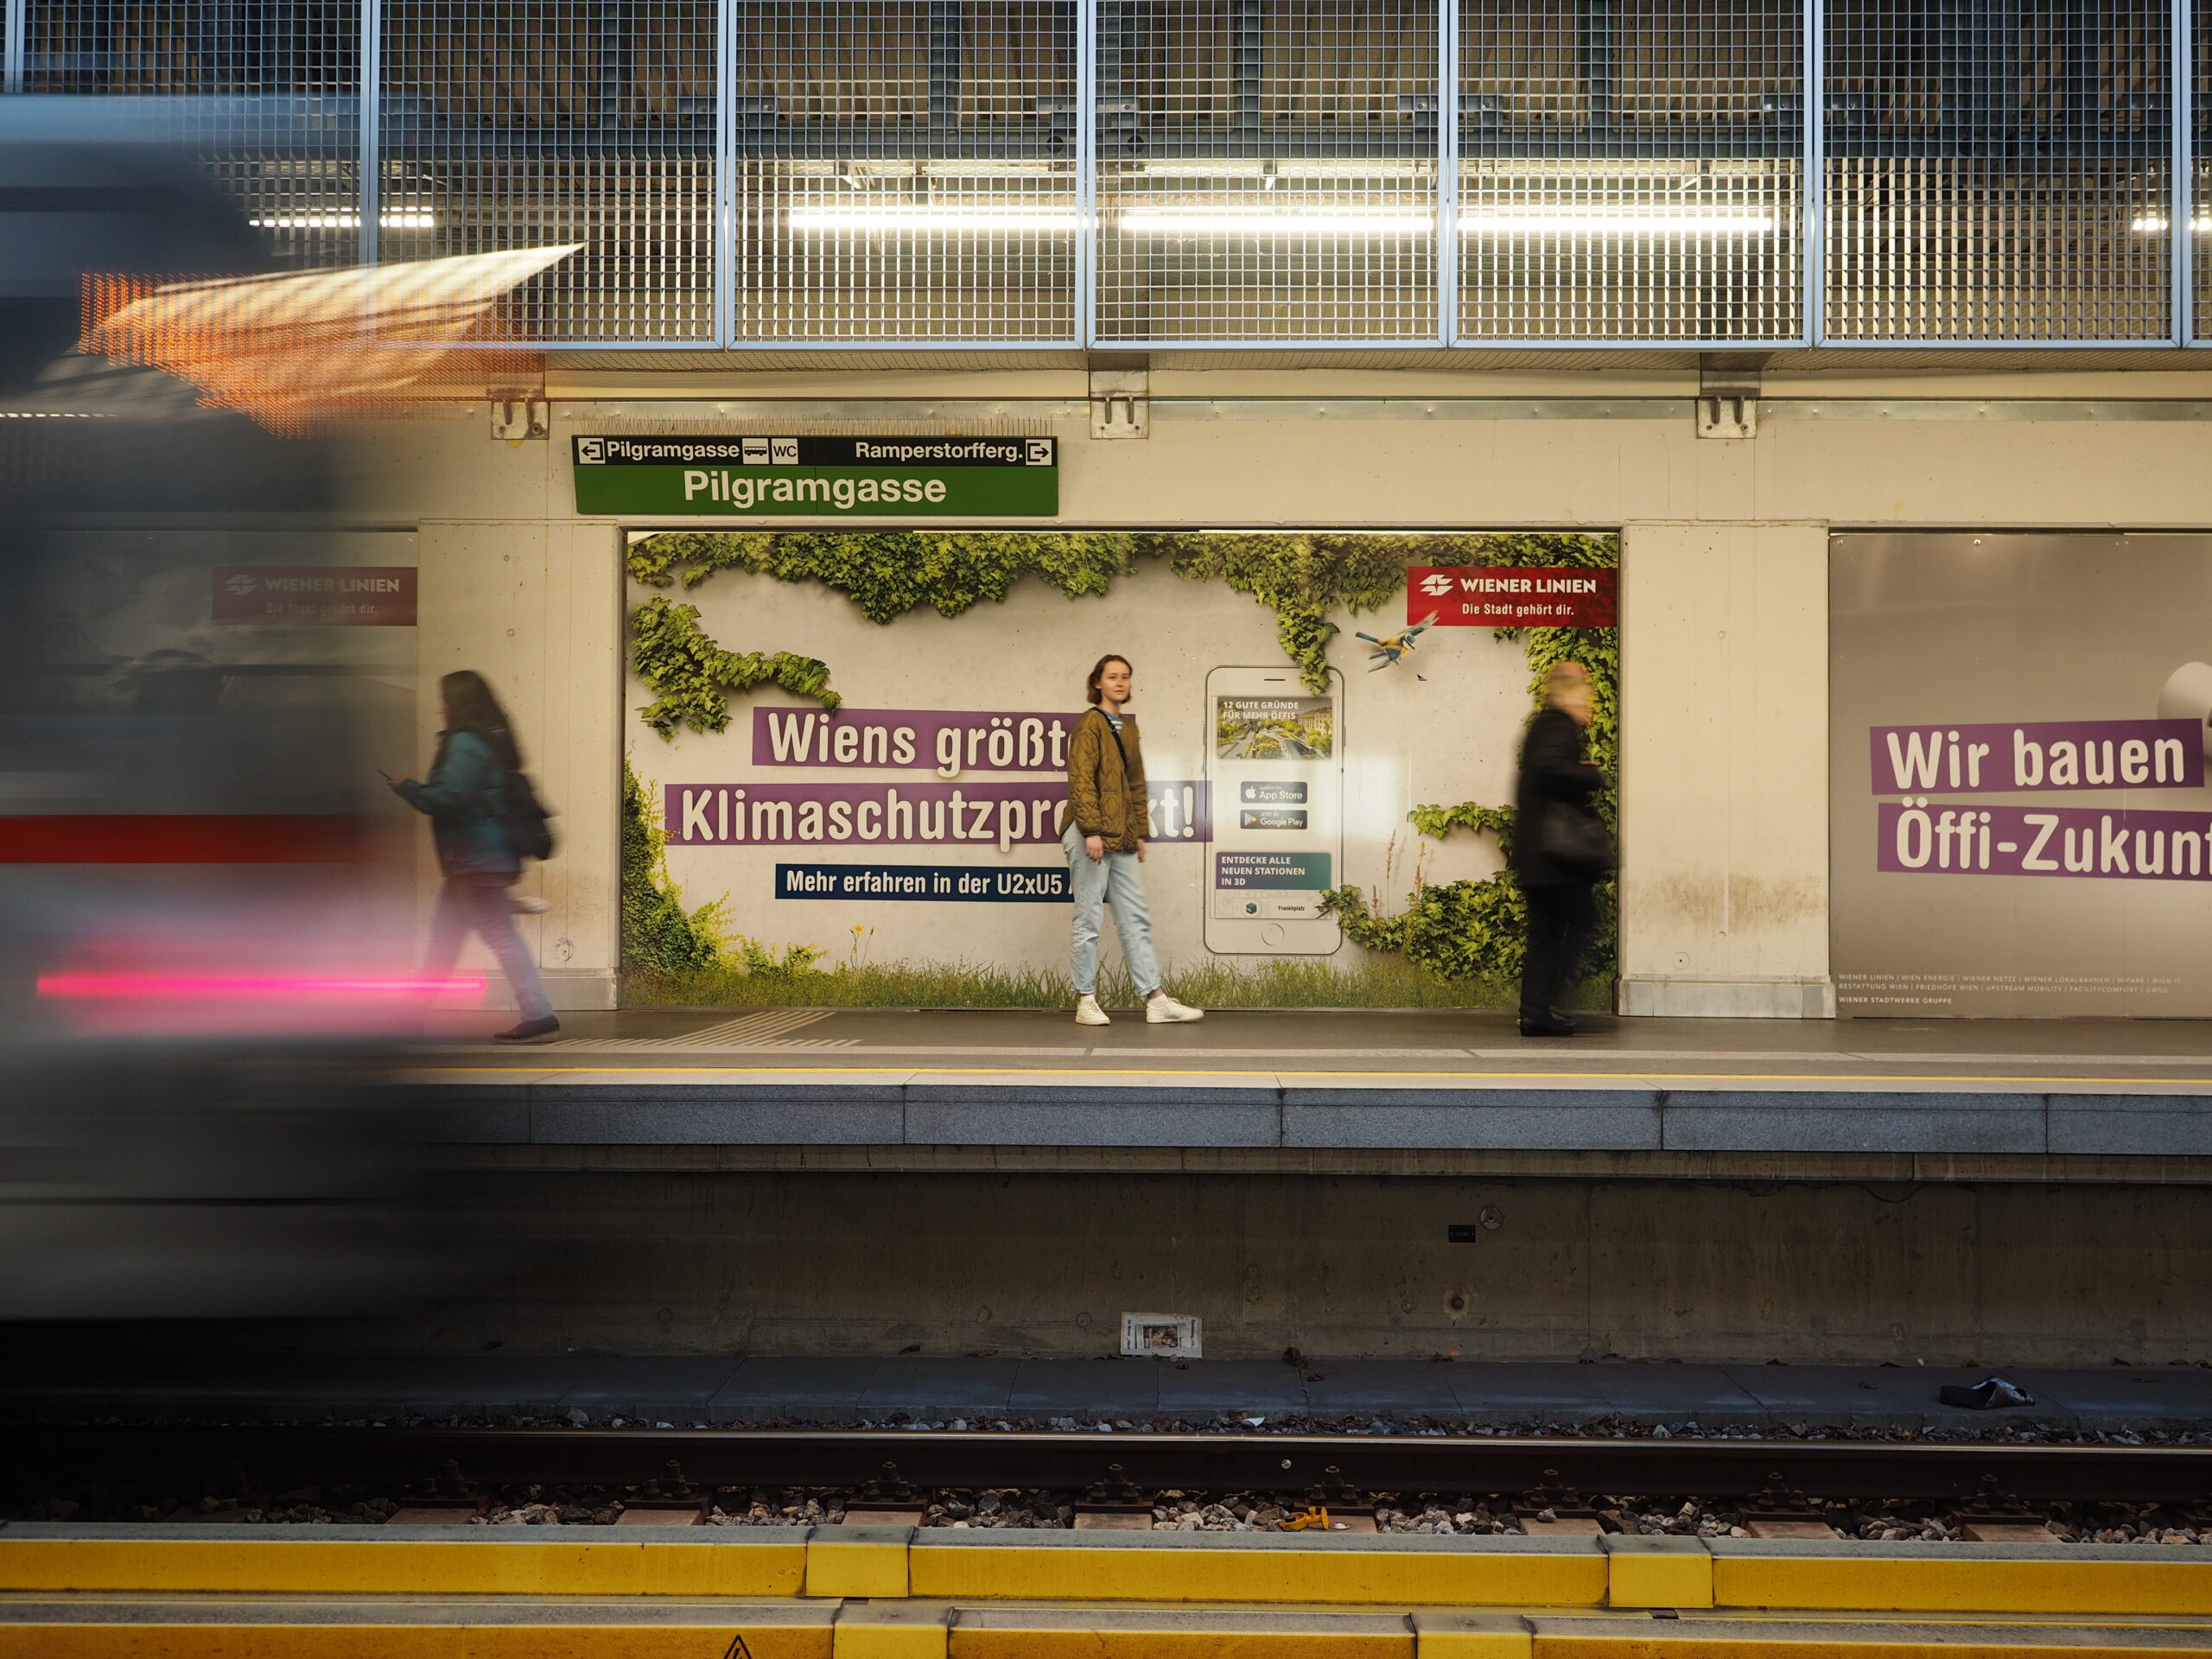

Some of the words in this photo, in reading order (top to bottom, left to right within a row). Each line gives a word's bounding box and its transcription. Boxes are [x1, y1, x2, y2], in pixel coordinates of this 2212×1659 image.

[607, 442, 740, 461] Pilgramgasse
[773, 444, 798, 458] WC
[855, 442, 1023, 462] Ramperstorfferg.
[683, 470, 947, 509] Pilgramgasse
[264, 578, 335, 593] WIENER
[340, 579, 400, 593] LINIEN
[1460, 578, 1532, 594] WIENER
[1536, 579, 1597, 594] LINIEN
[359, 603, 378, 614] dir.
[1462, 603, 1480, 614] Die
[1484, 603, 1513, 615] Stadt
[1516, 604, 1553, 618] gehört
[1556, 604, 1574, 615] dir.
[1223, 701, 1234, 709] 12
[1236, 701, 1259, 709] GUTE
[1261, 700, 1300, 709] GRÜNDE
[1223, 709, 1241, 719] FÜR
[1243, 711, 1268, 720] MEHR
[1271, 710, 1296, 720] ÖFFIS
[767, 712, 917, 765] Wiens
[936, 716, 1070, 778] größt
[1886, 729, 1990, 790] Wir
[2013, 728, 2184, 786] bauen
[1259, 791, 1278, 801] App
[1279, 791, 1303, 800] Store
[1260, 817, 1287, 828] Google
[1287, 817, 1304, 828] Play
[1269, 856, 1291, 865] ALLE
[1221, 867, 1253, 875] NEUEN
[786, 870, 837, 892] Mehr
[843, 871, 926, 893] erfahren
[933, 872, 951, 893] in
[958, 872, 991, 894] der
[997, 873, 1063, 895] U2xU5
